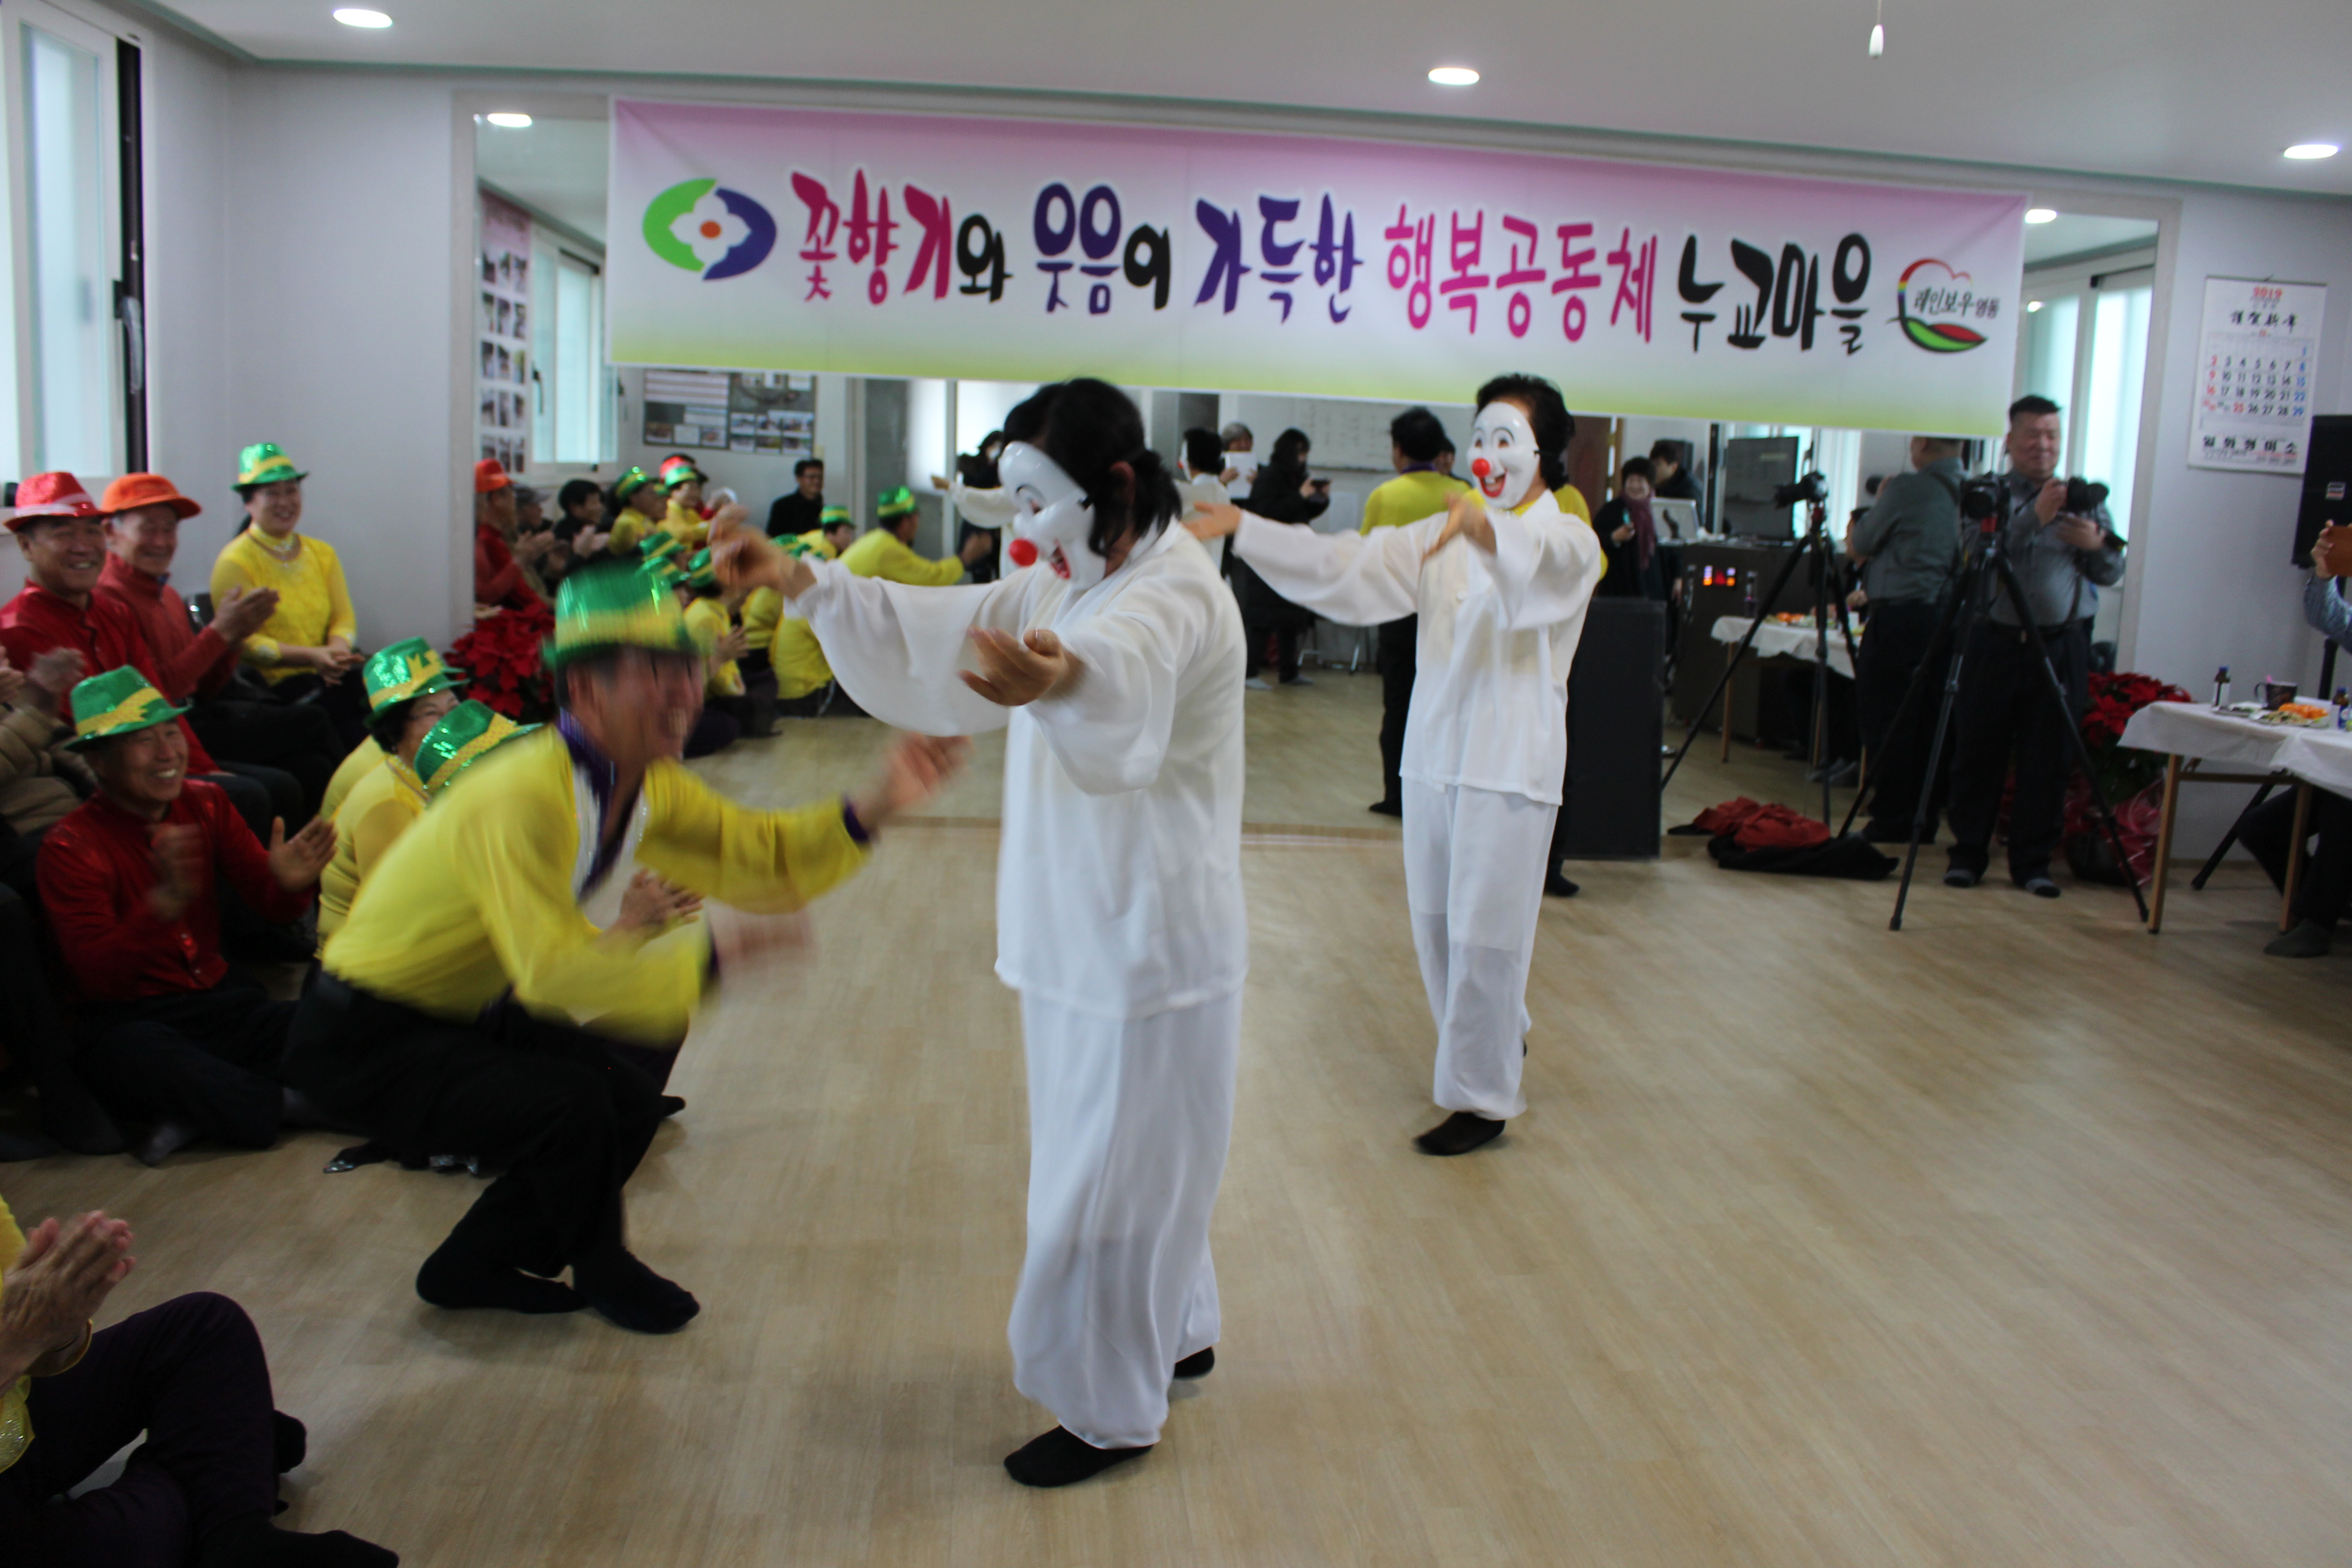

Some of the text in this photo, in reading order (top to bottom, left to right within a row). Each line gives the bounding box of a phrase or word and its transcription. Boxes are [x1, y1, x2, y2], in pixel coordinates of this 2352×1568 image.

[790, 169, 1871, 356] 꽃향기와 웃음이 가득한 행복공동체 누교마을
[2302, 347, 2307, 356] 1
[2211, 355, 2305, 372] 2 3 4 5 6 7 8
[2209, 370, 2306, 387] 9 10 11 12 13 14 15
[2207, 385, 2305, 402] 16 17 18 19 20 21 22
[2234, 402, 2244, 413] 25
[2249, 403, 2259, 414] 26
[2263, 404, 2273, 416] 27
[2277, 405, 2288, 416] 28
[2293, 406, 2304, 416] 29
